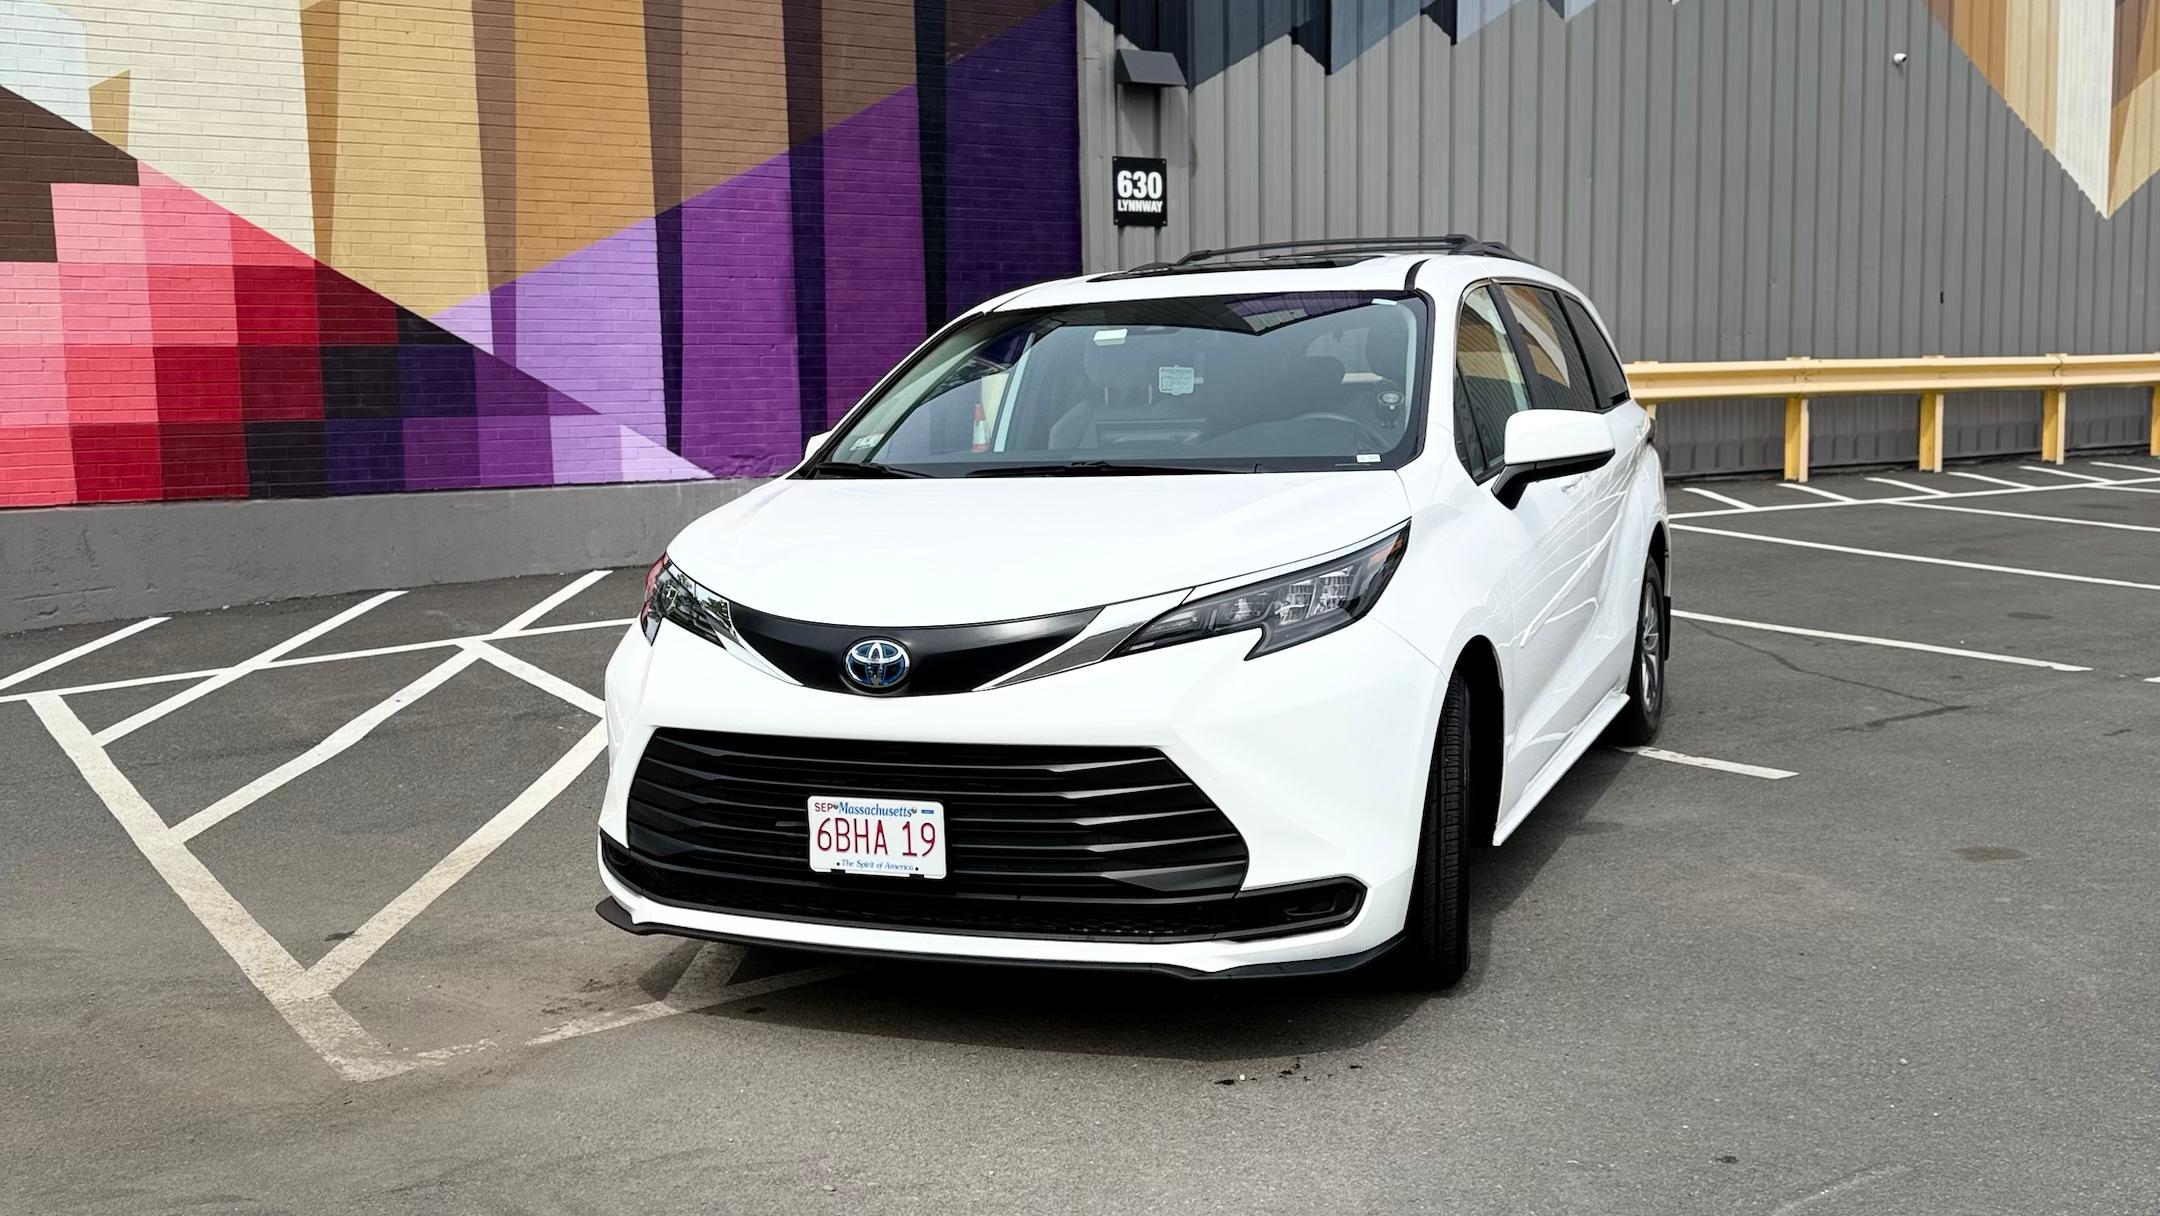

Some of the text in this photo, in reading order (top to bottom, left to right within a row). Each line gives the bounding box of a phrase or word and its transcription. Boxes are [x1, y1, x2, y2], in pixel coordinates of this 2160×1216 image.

[1117, 170, 1163, 200] 630
[1117, 199, 1163, 213] LYNNWAY
[814, 802, 832, 813] SEP
[838, 801, 912, 818] Massachusetts
[817, 817, 936, 857] 6BHA 19
[841, 859, 914, 871] The Spirit of America
